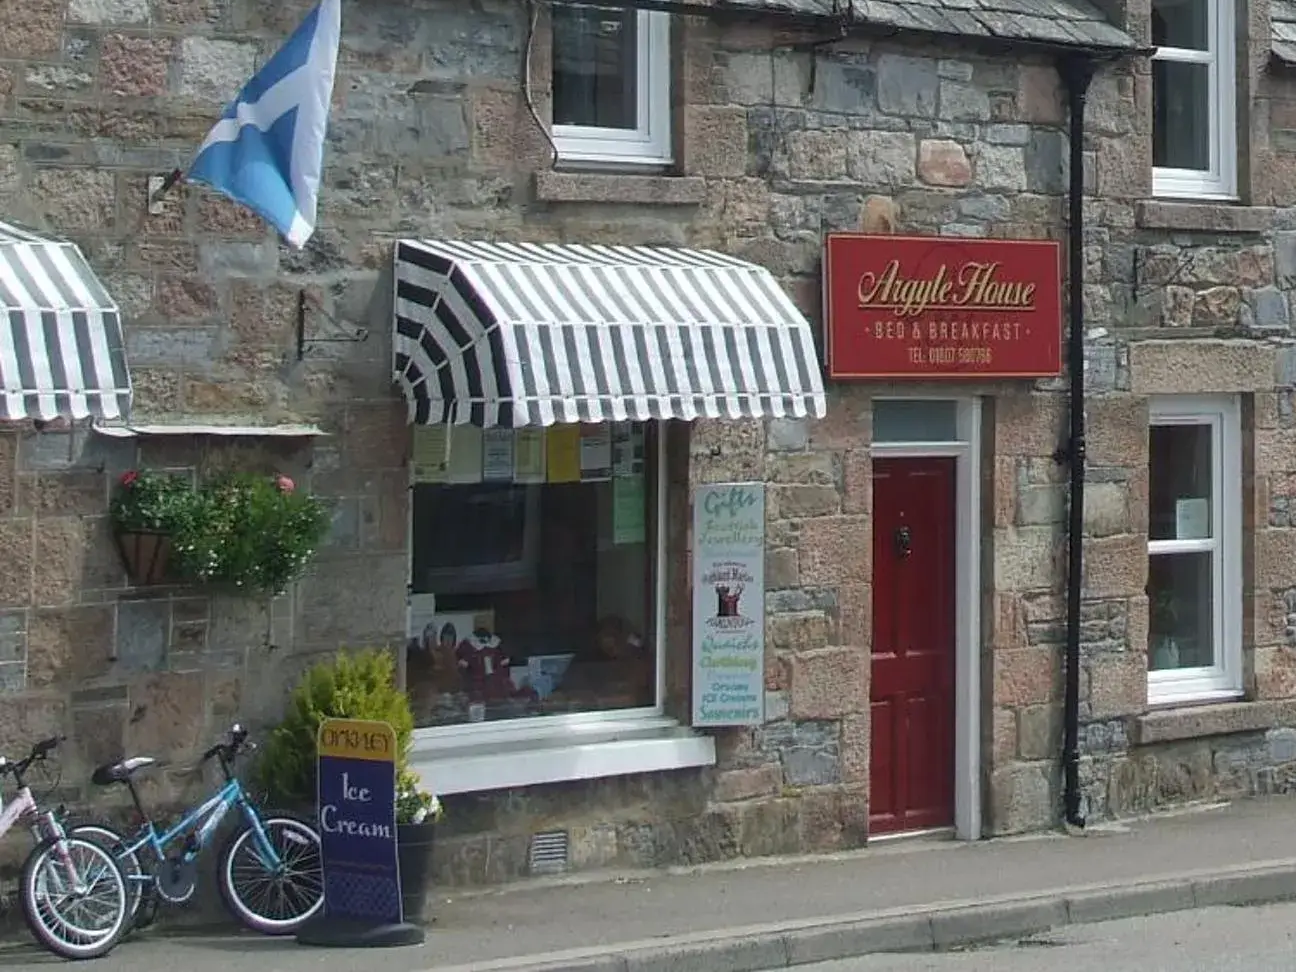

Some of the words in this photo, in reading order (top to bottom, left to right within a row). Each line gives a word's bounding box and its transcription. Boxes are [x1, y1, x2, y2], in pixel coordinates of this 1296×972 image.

[858, 259, 952, 315] Argyle
[953, 260, 1036, 306] House
[875, 321, 906, 339] BED
[911, 321, 921, 339] &
[928, 322, 1021, 341] BREAKFAST
[703, 486, 757, 518] Gifts
[341, 772, 373, 801] Ice
[321, 804, 390, 838] Cream
